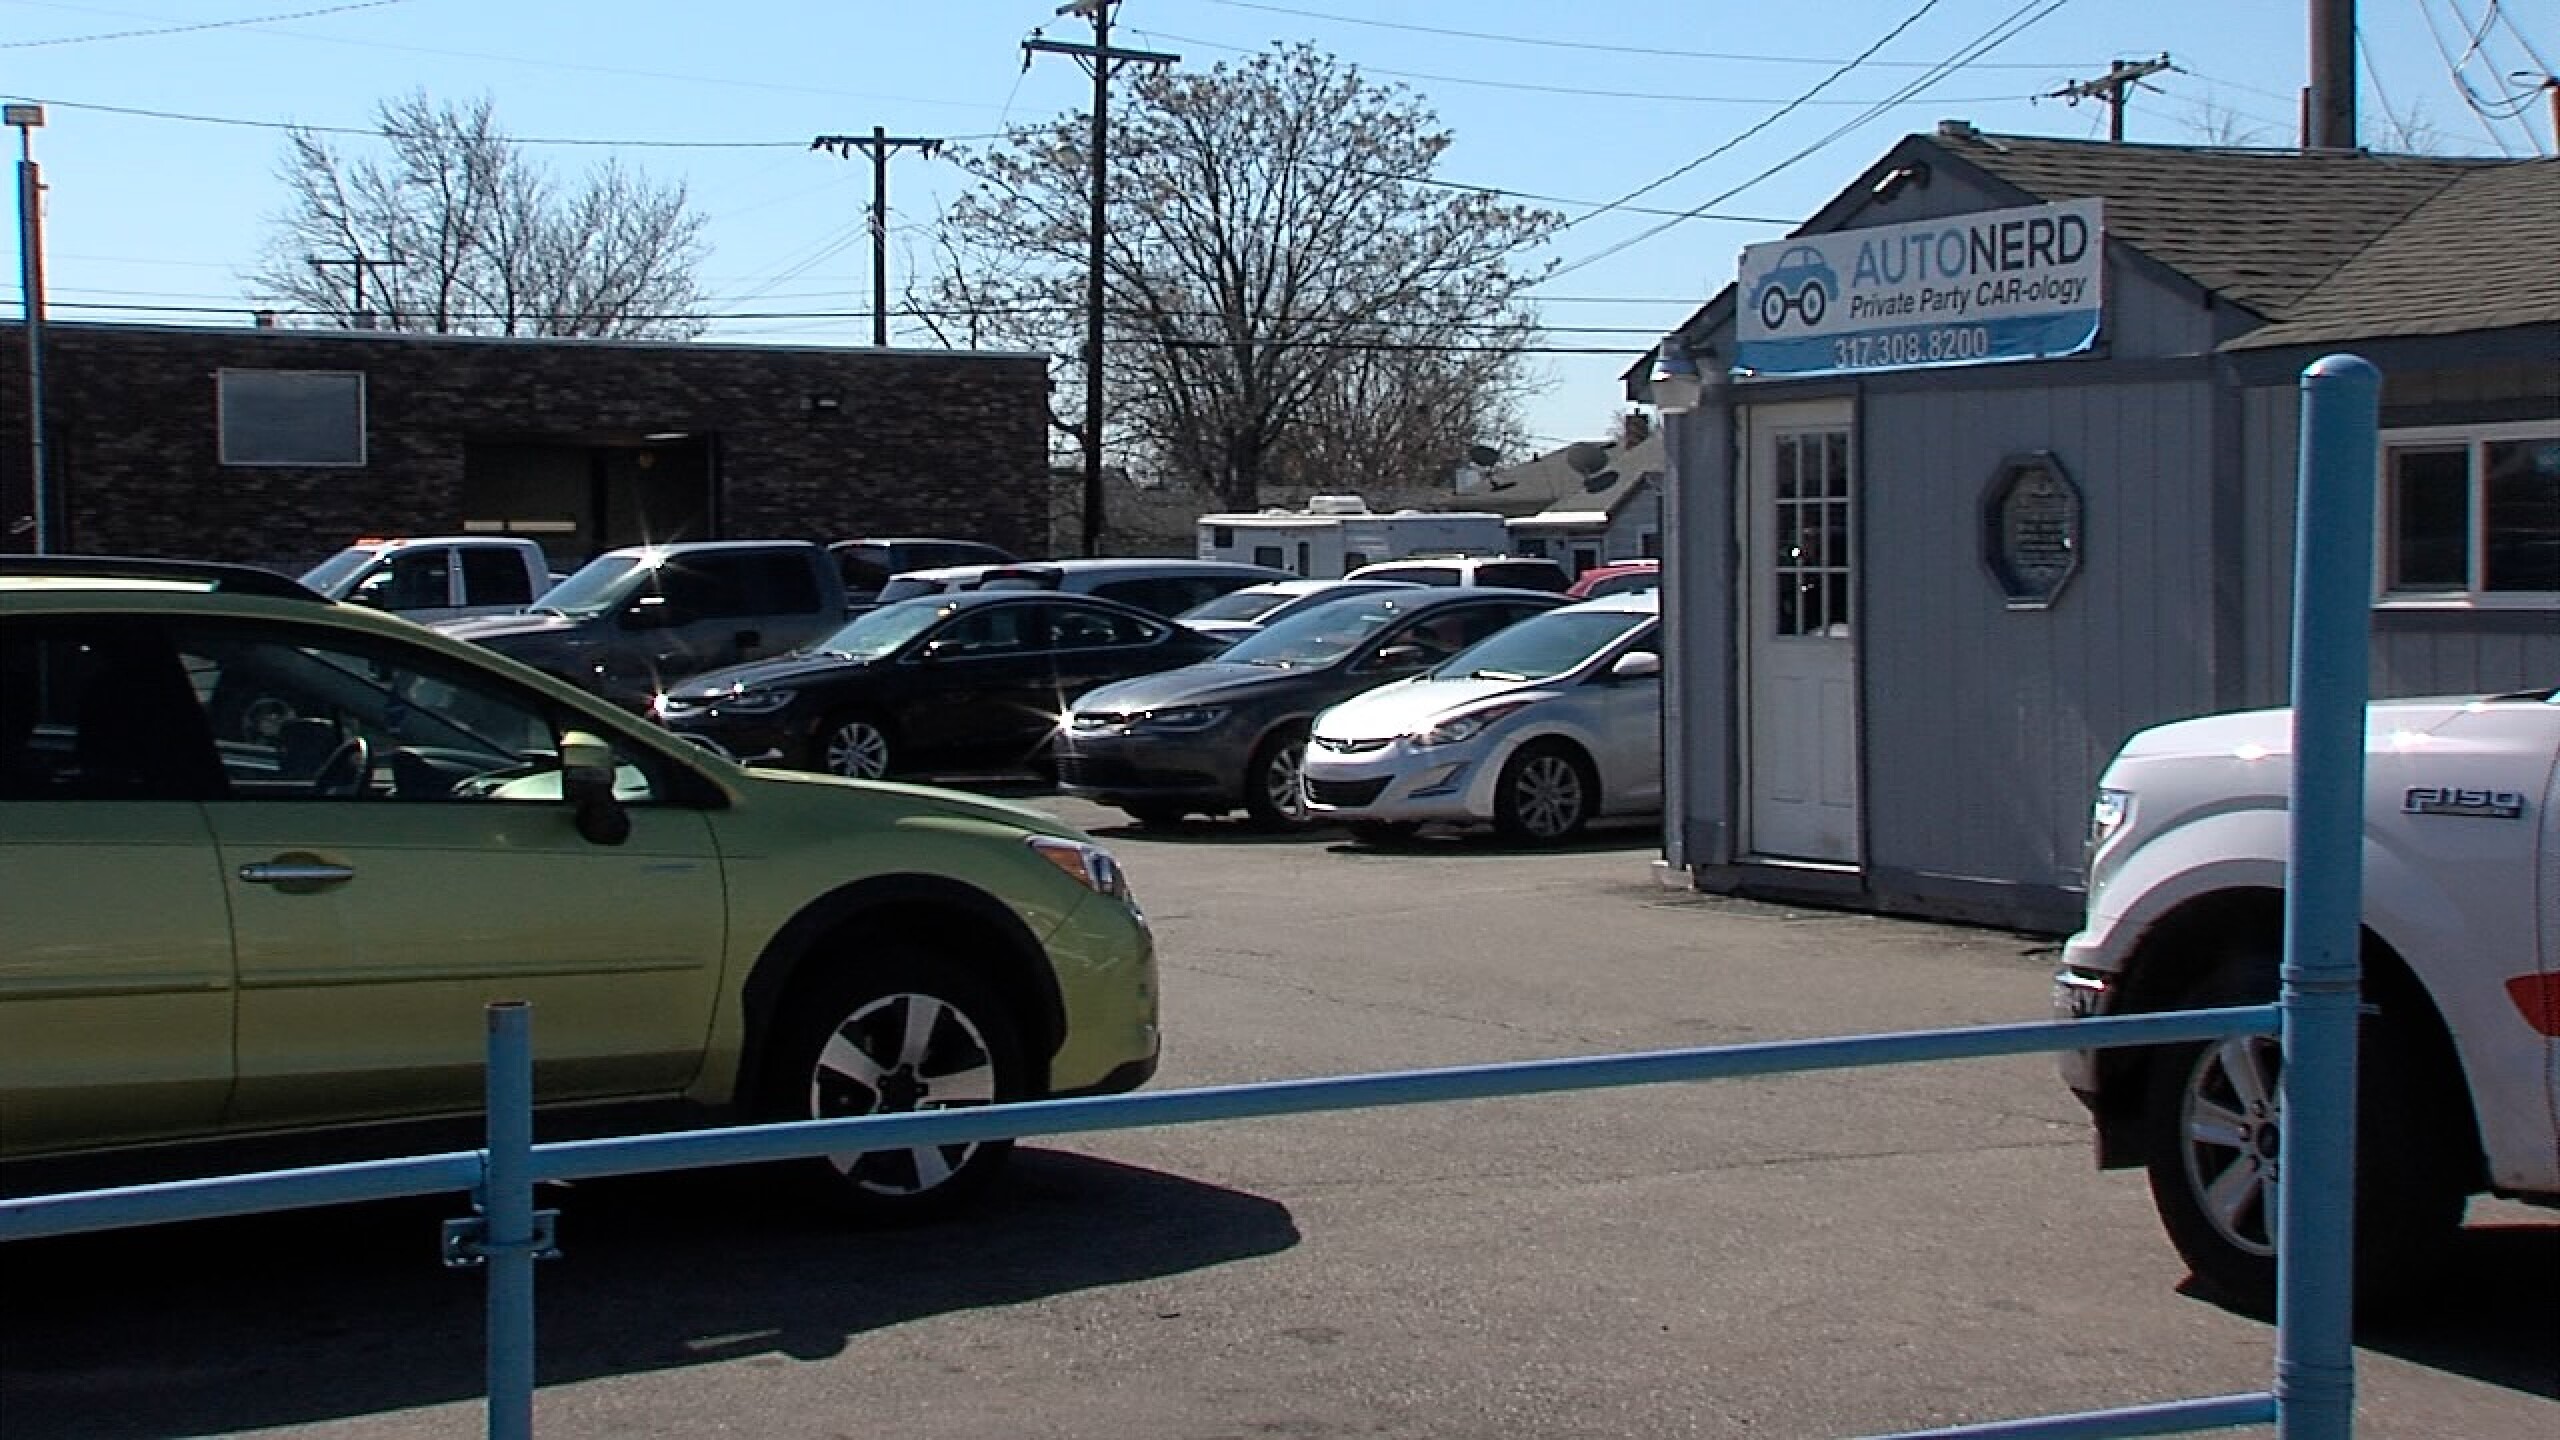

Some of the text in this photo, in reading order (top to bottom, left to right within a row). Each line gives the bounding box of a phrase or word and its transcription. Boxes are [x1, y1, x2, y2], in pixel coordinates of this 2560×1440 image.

[1852, 214, 2087, 288] AUTONERD
[1850, 274, 2087, 318] Private Party CAR-ology
[1834, 327, 1988, 369] 317.308.8200
